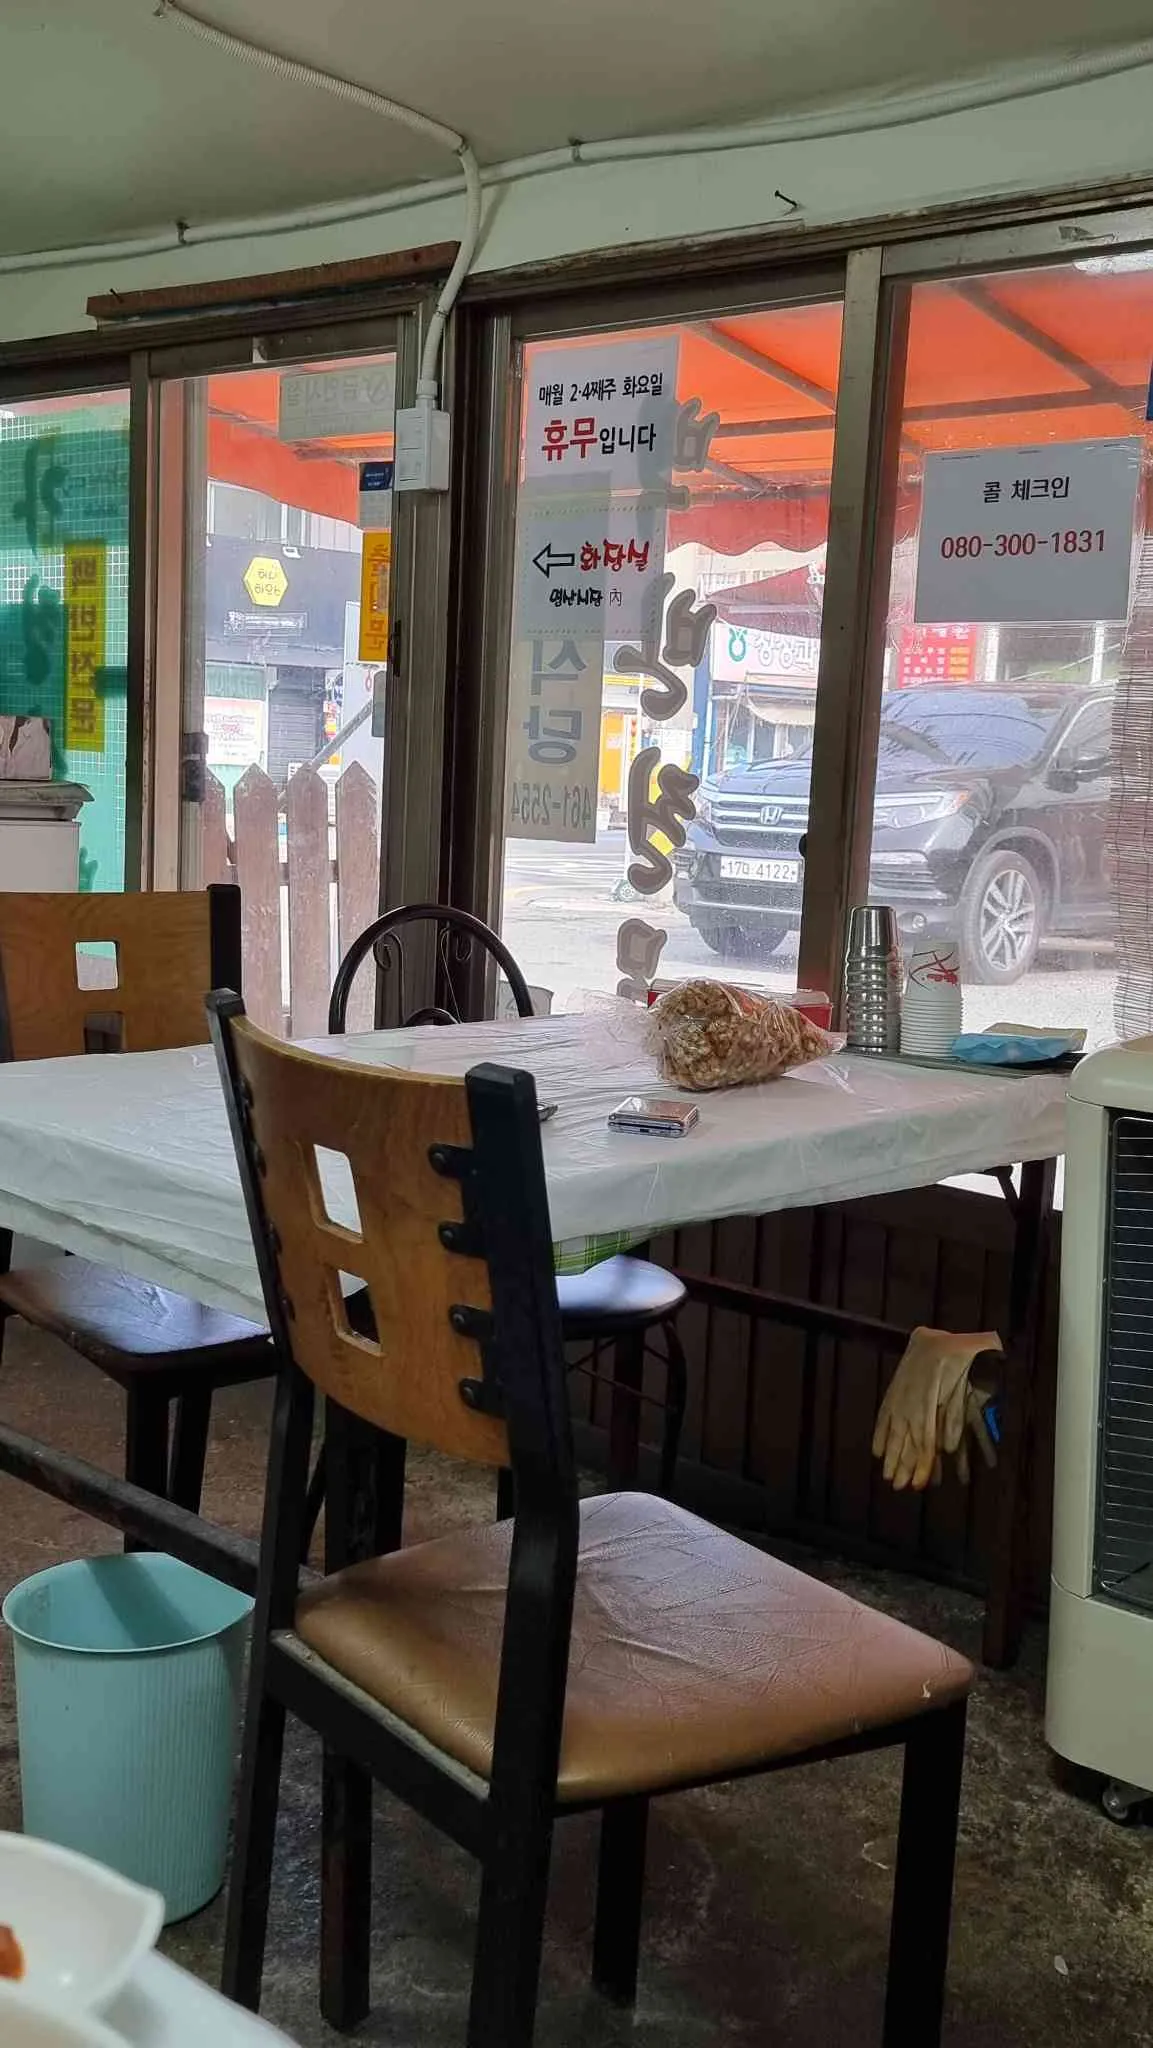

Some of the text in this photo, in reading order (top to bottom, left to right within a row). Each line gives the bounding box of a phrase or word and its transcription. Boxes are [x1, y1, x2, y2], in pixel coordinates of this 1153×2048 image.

[539, 384, 563, 406] 매월
[622, 372, 663, 398] 화요일
[541, 416, 657, 463] 휴무입니다
[983, 475, 1070, 503] 콜 체크인
[580, 538, 650, 573] 화장실
[941, 529, 1105, 560] 080-300-1831
[756, 863, 790, 880] 4122
